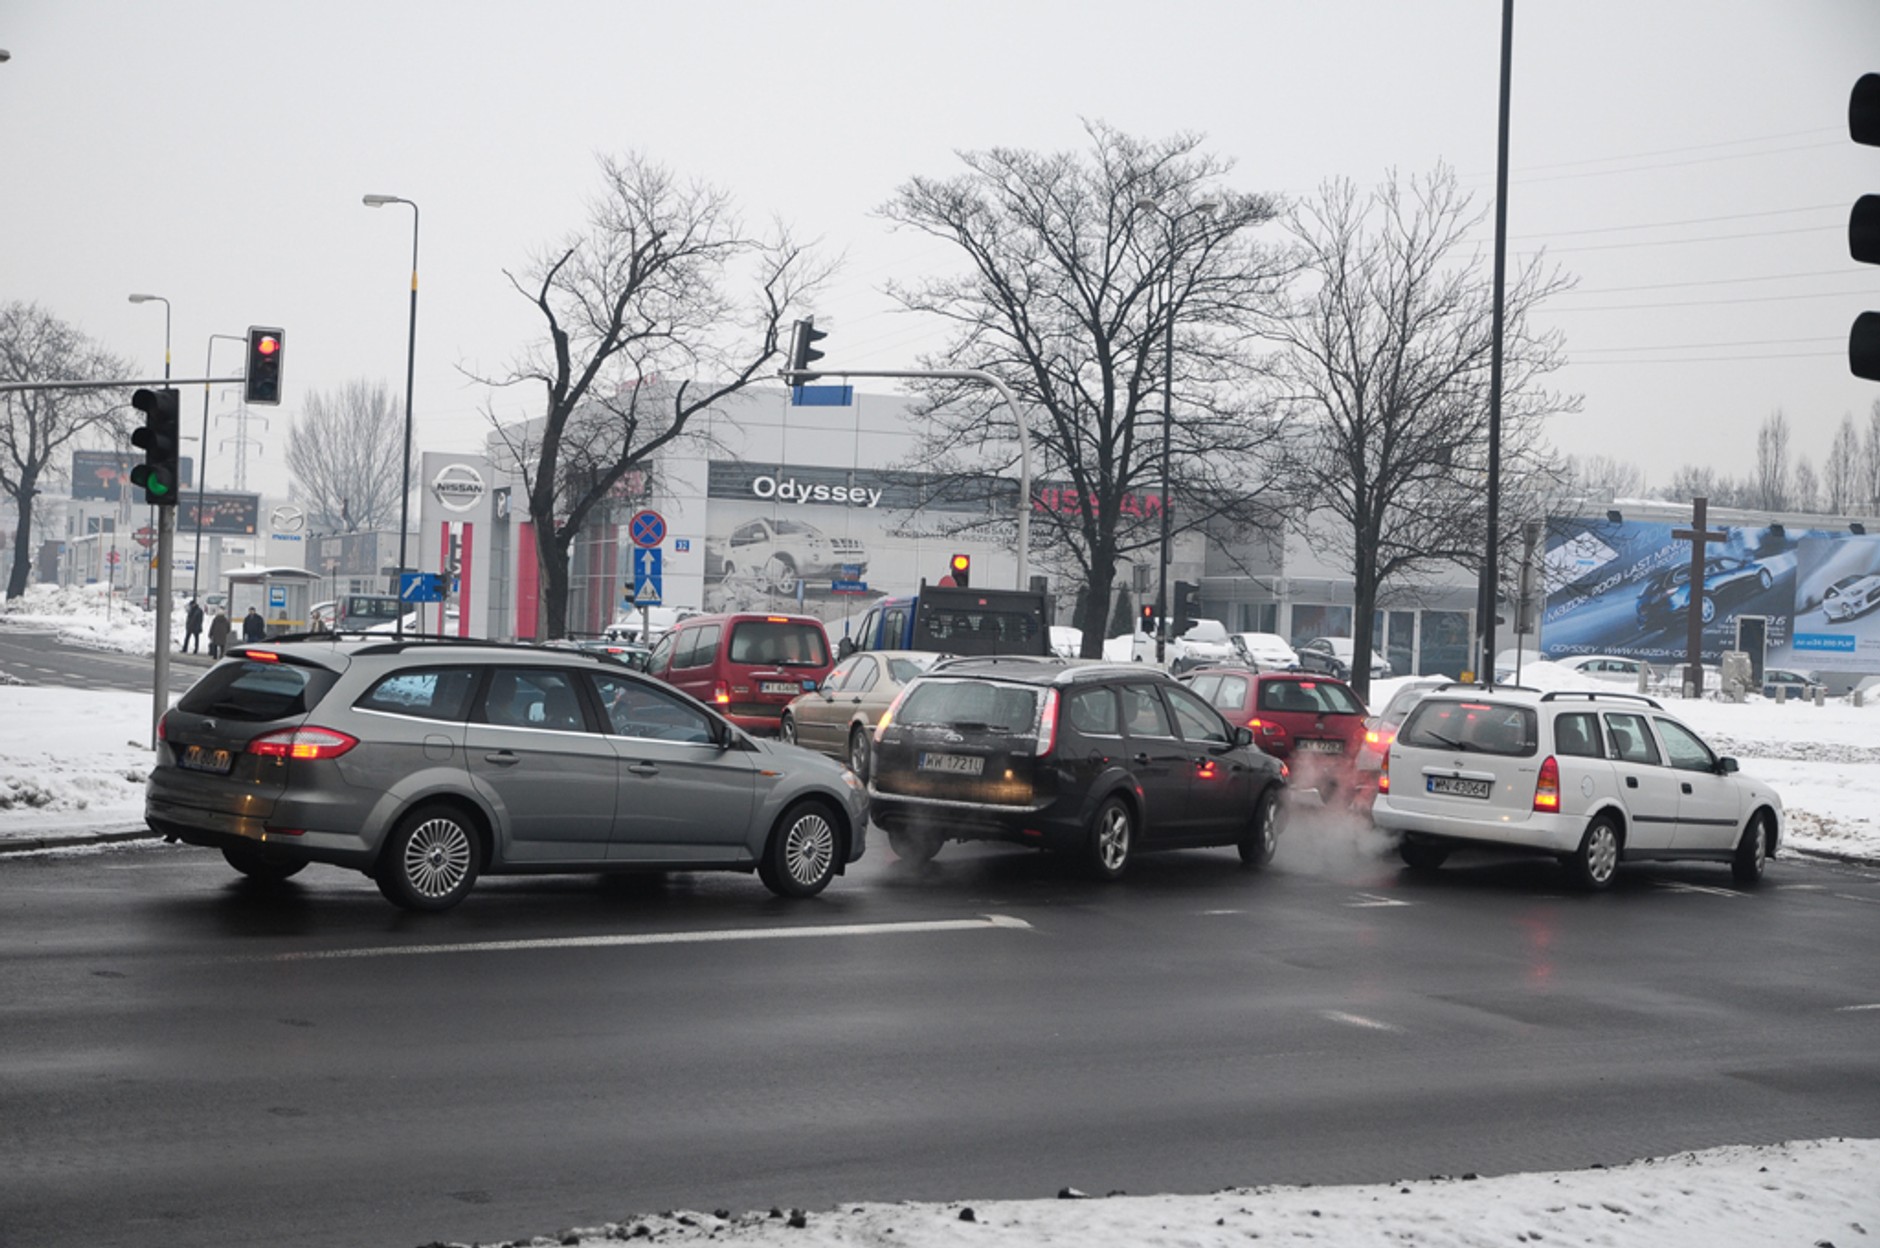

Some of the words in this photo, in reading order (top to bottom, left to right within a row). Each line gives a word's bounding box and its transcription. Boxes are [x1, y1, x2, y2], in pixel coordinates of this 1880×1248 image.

[437, 482, 481, 493] NISSAN
[753, 476, 882, 508] Odyssey
[1549, 643, 1598, 653] ODYSSEY
